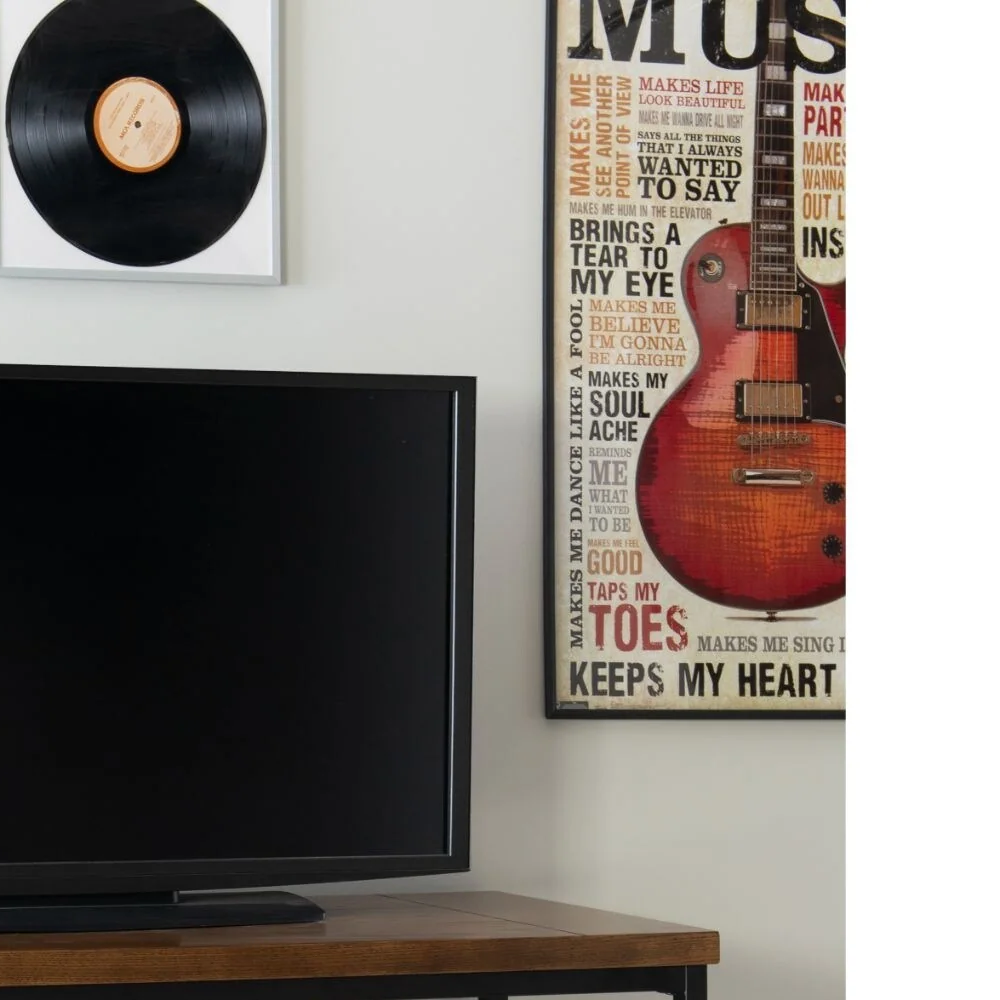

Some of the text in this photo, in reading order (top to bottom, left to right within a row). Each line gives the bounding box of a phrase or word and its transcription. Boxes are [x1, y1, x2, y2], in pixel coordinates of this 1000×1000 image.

[639, 77, 743, 95] MAKES LIFE
[639, 94, 746, 109] LOOK BEAUTIFUL
[638, 110, 744, 129] MAKES ME WANNA DRIVE ALL NIGHT
[570, 73, 591, 197] MAKES ME
[596, 75, 612, 197] SEE ANOTHER
[616, 76, 631, 199] POINT OF VIEW
[638, 131, 741, 143] SAYS ALL THE THINGS
[637, 142, 743, 158] THAT I ALWAYS
[637, 156, 742, 178] WANTED
[637, 176, 741, 202] TO SAY
[803, 168, 845, 191] WANNA
[569, 202, 712, 220] MAKES ME HUM IN THE ELEVATOR
[803, 193, 832, 221] OUT
[570, 218, 681, 246] BRINGS A
[570, 243, 668, 270] TEAR TO
[571, 268, 674, 297] MY EYE
[589, 299, 676, 315] MAKES ME
[589, 315, 680, 334] BELIEVE
[589, 334, 687, 351] I'M GONNA
[589, 352, 686, 367] BE ALRIGHT
[588, 370, 668, 389] MAKES MY
[590, 390, 650, 418] SOUL
[589, 420, 638, 442] ACHE
[588, 447, 632, 458] REMINDS
[570, 299, 583, 649] MAKES ME DANCE LIKE A FOOL
[588, 460, 628, 486] ME
[589, 489, 628, 503] WHAT
[589, 505, 630, 515] I WANTED
[589, 517, 632, 533] TO BE
[587, 538, 640, 548] MAKES ME FEEL
[587, 549, 643, 576] GOOD
[587, 582, 660, 601] TAPS MY
[588, 603, 689, 652] TOES
[697, 635, 758, 652] MAKES
[763, 636, 789, 652] ME
[793, 636, 835, 653] SING
[570, 661, 837, 698] KEEPS MY HEART
